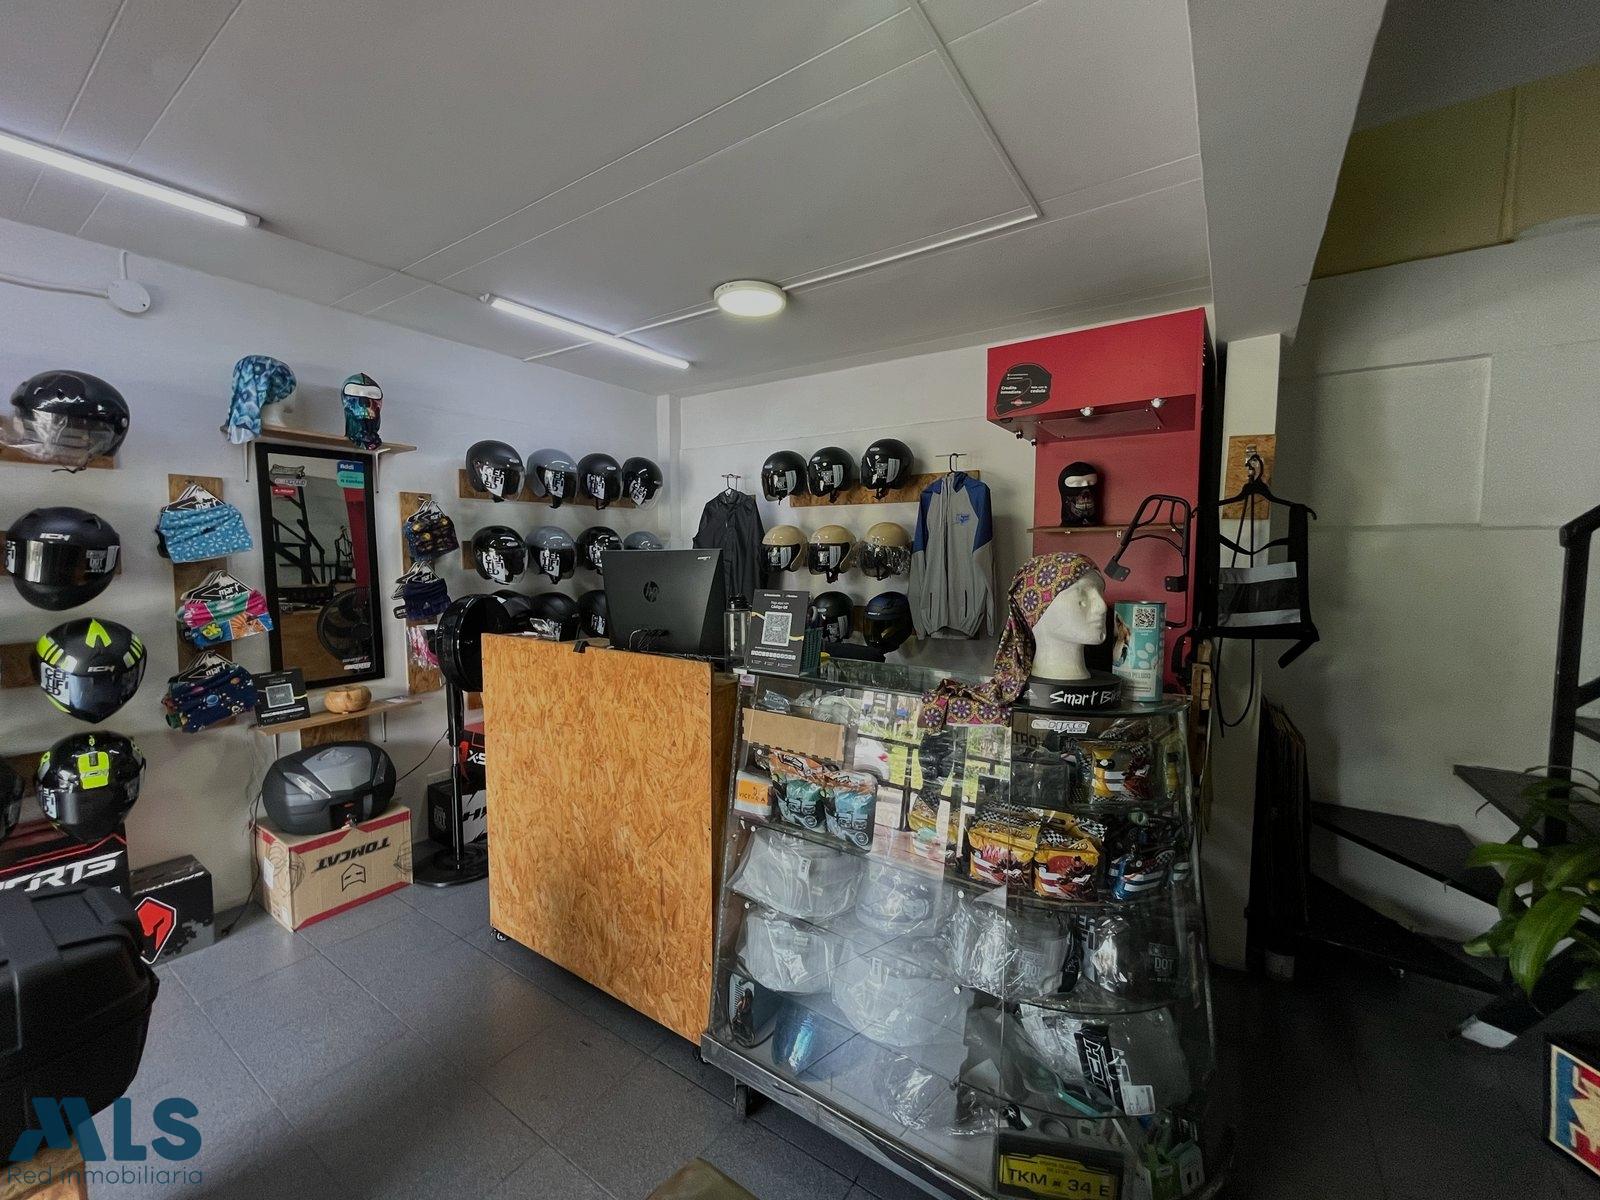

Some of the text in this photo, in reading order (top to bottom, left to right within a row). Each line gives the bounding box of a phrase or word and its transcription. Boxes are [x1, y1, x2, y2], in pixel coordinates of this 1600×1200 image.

[1049, 690, 1099, 707] Smart
[314, 836, 392, 873] TOMCAT
[1007, 1168, 1111, 1197] TKM 34 E
